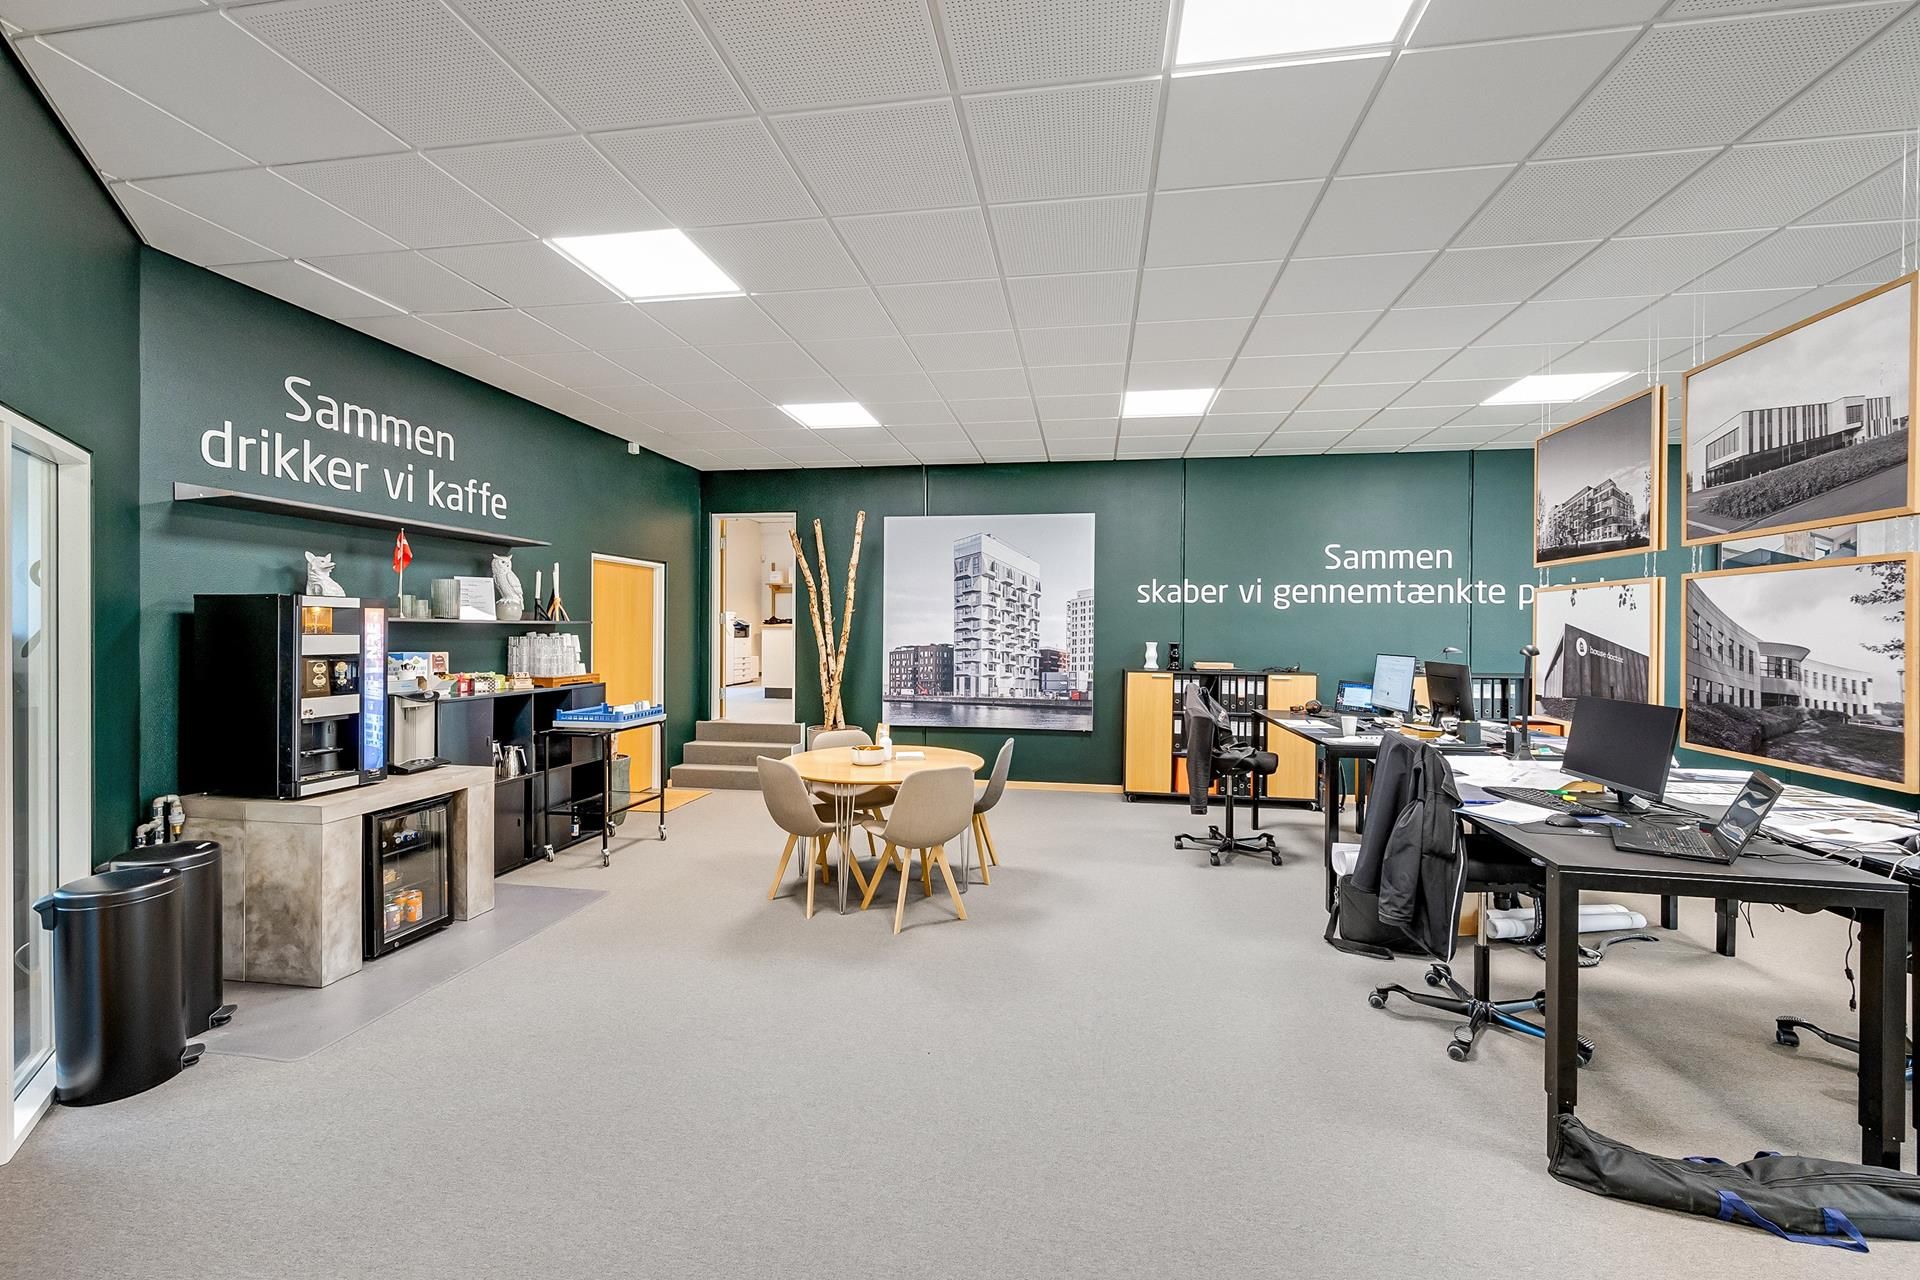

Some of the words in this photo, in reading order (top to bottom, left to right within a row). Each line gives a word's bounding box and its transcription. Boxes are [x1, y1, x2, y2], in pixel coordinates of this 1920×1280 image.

[284, 375, 456, 462] Sammen
[201, 420, 370, 493] drikker
[383, 463, 415, 503] vi
[428, 468, 509, 520] kaffe
[1324, 543, 1454, 570] Sammen
[1136, 577, 1229, 605] skaber
[1238, 577, 1262, 604] vi
[1273, 579, 1506, 610] gennemtænkte
